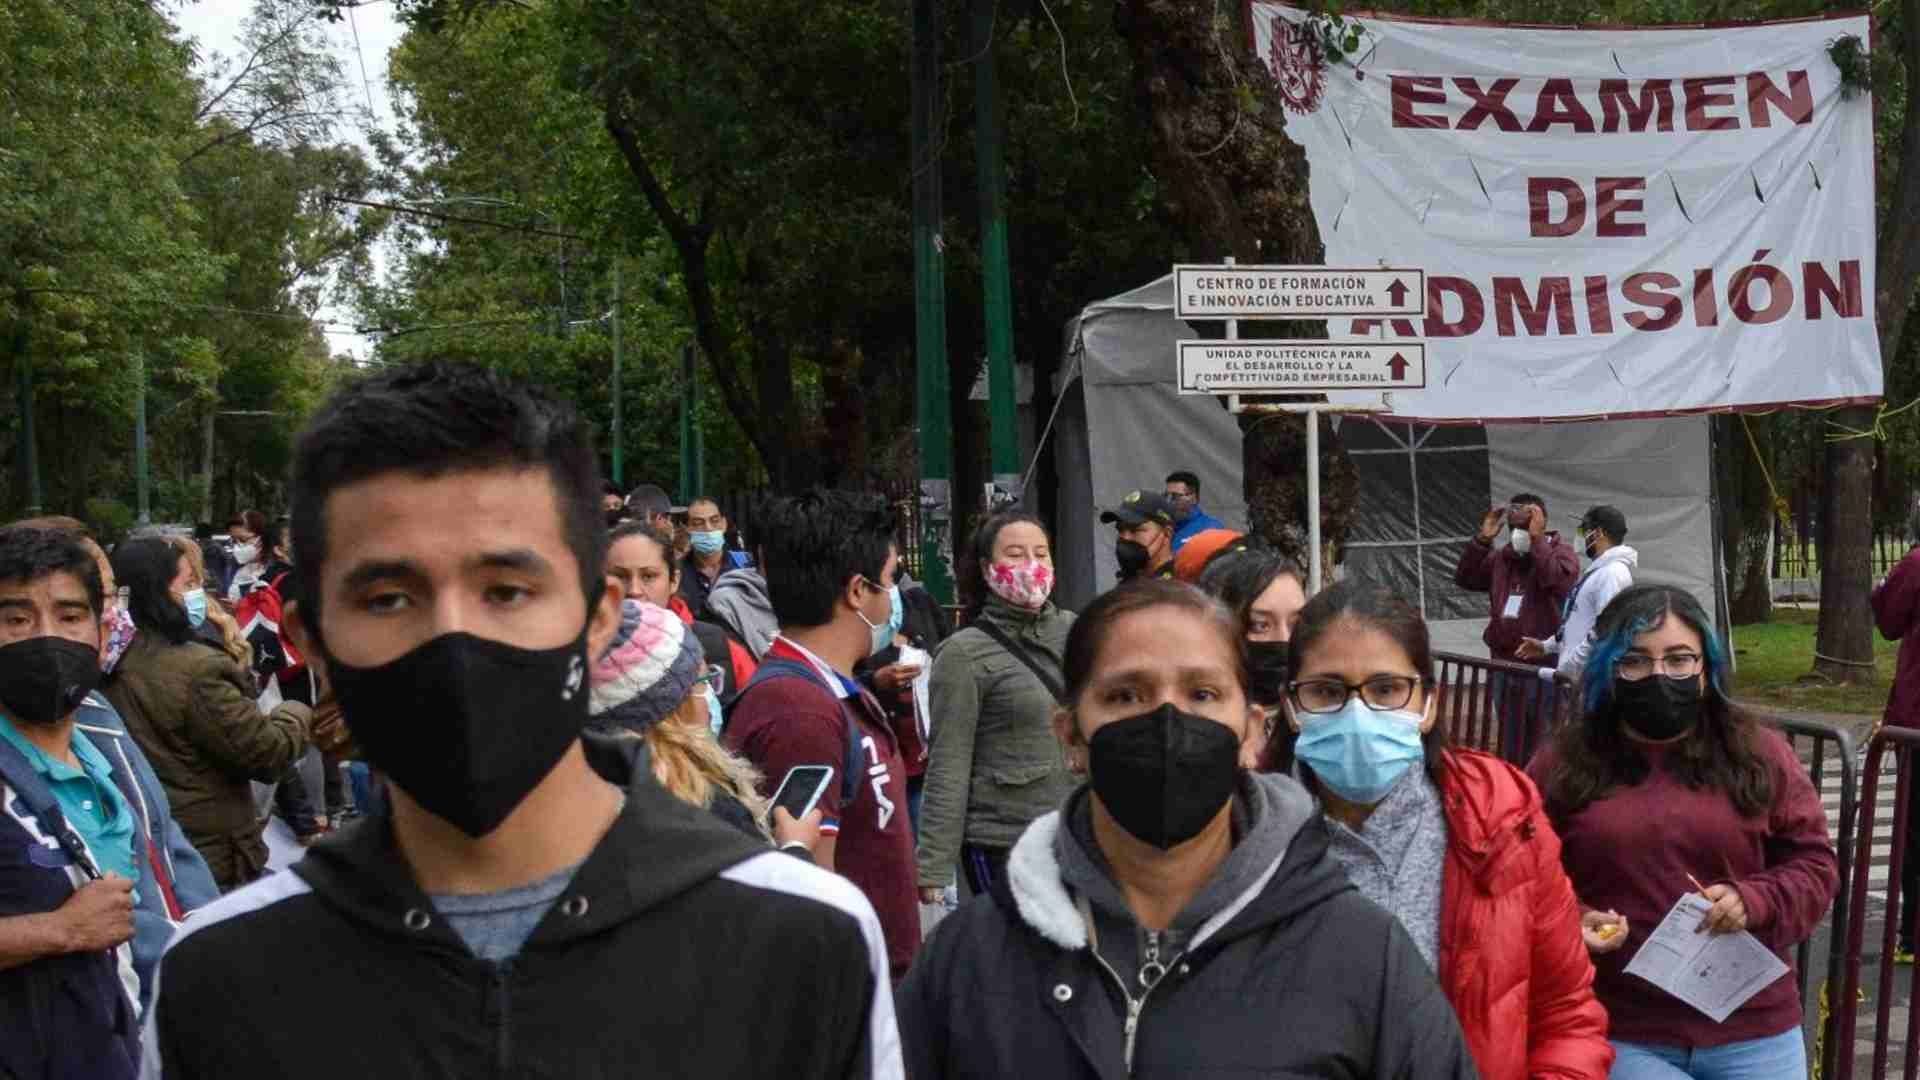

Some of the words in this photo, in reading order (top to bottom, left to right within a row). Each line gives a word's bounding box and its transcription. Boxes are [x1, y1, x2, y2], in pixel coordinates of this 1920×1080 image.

[1390, 70, 1814, 133] EXAMEN
[1527, 177, 1647, 237] DE
[1196, 278, 1254, 290] CENTRO
[1259, 278, 1277, 290] DE
[1281, 274, 1366, 290] FORMACIÓN
[1188, 295, 1197, 307] E
[1201, 292, 1290, 307] INNOVACIÓN
[1296, 295, 1375, 307] EDUCATIVA
[1350, 249, 1864, 338] DMISIÓN
[1206, 350, 1252, 359] UNIDAD
[1341, 350, 1371, 359] PARA
[1225, 362, 1240, 370] EL
[1244, 362, 1323, 370] DESARROLLO
[1327, 362, 1334, 370] Y
[1339, 362, 1353, 370] LA
[1303, 373, 1386, 382] EMPRESARIAL
